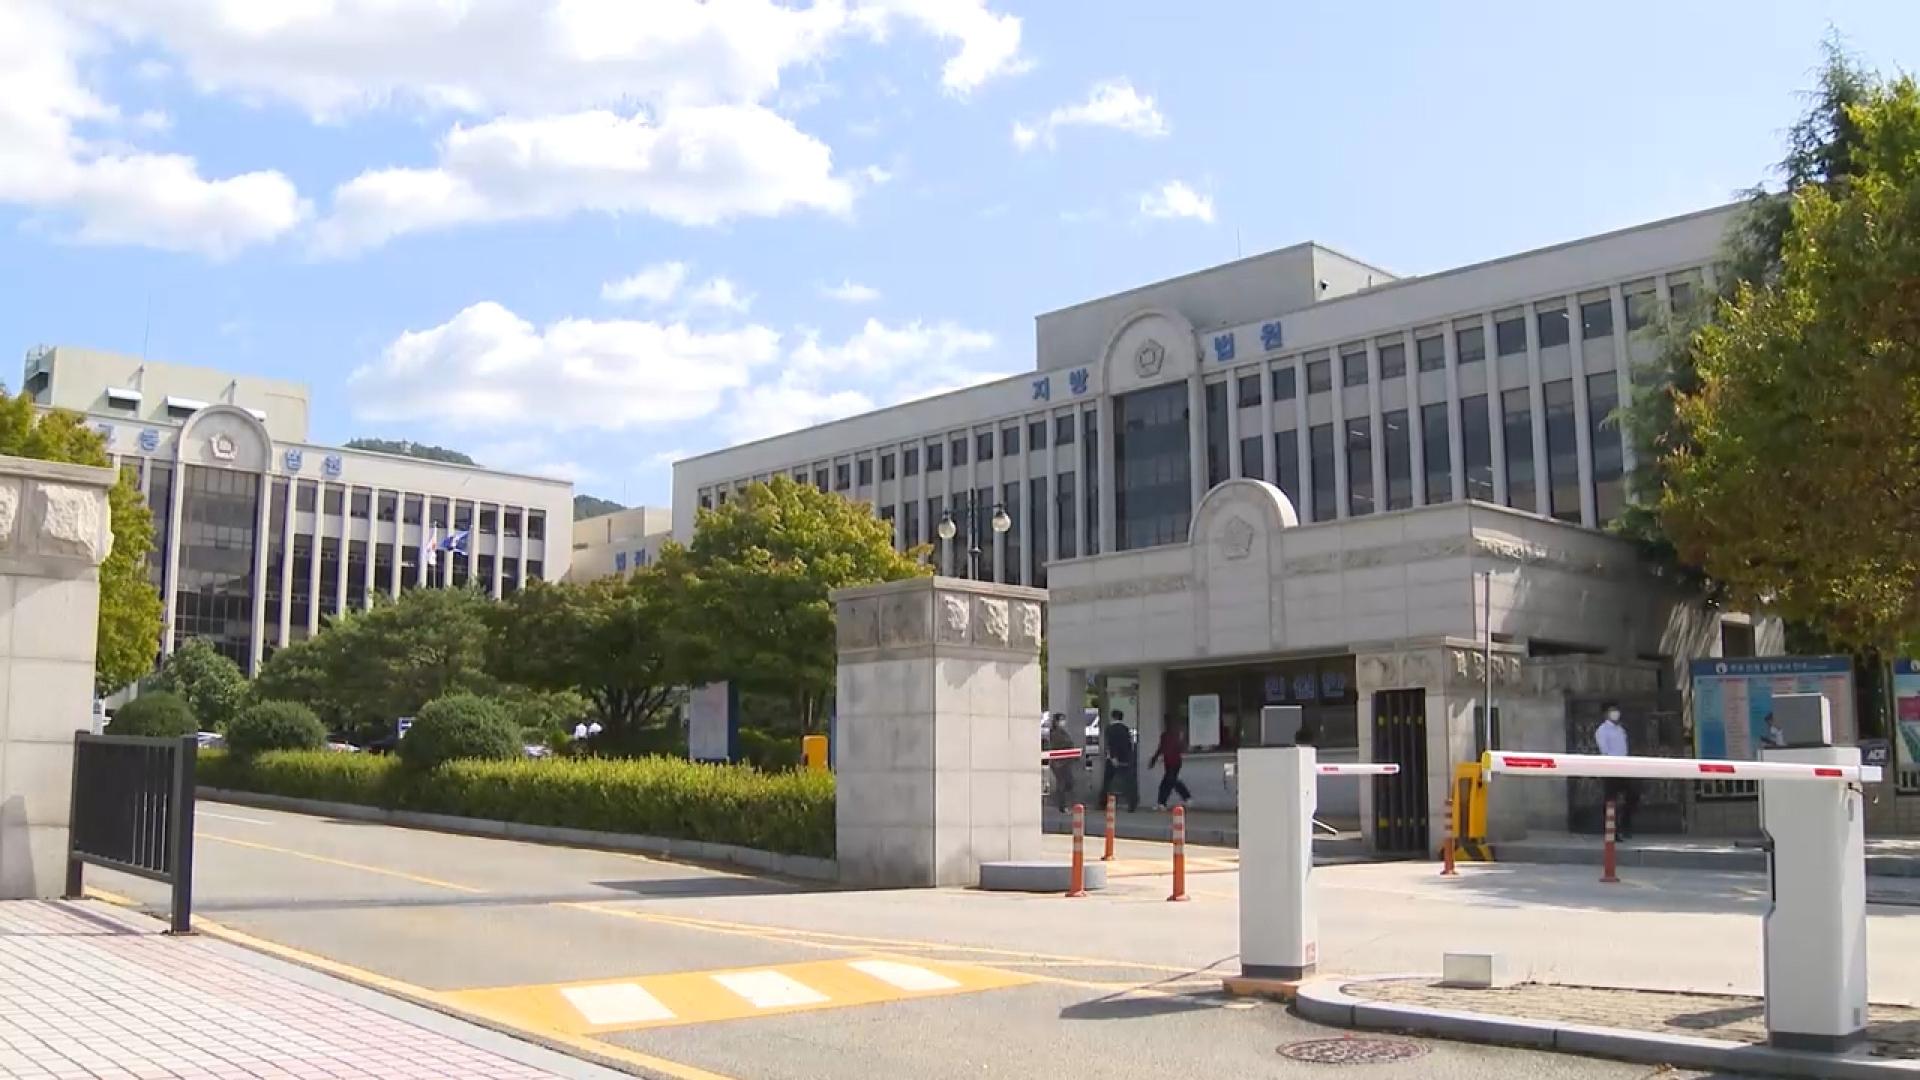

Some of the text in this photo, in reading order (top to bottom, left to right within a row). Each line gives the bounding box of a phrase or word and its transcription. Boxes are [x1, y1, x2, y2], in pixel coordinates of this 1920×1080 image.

[1032, 321, 1283, 400] 지방 법원
[285, 449, 343, 476] 법원
